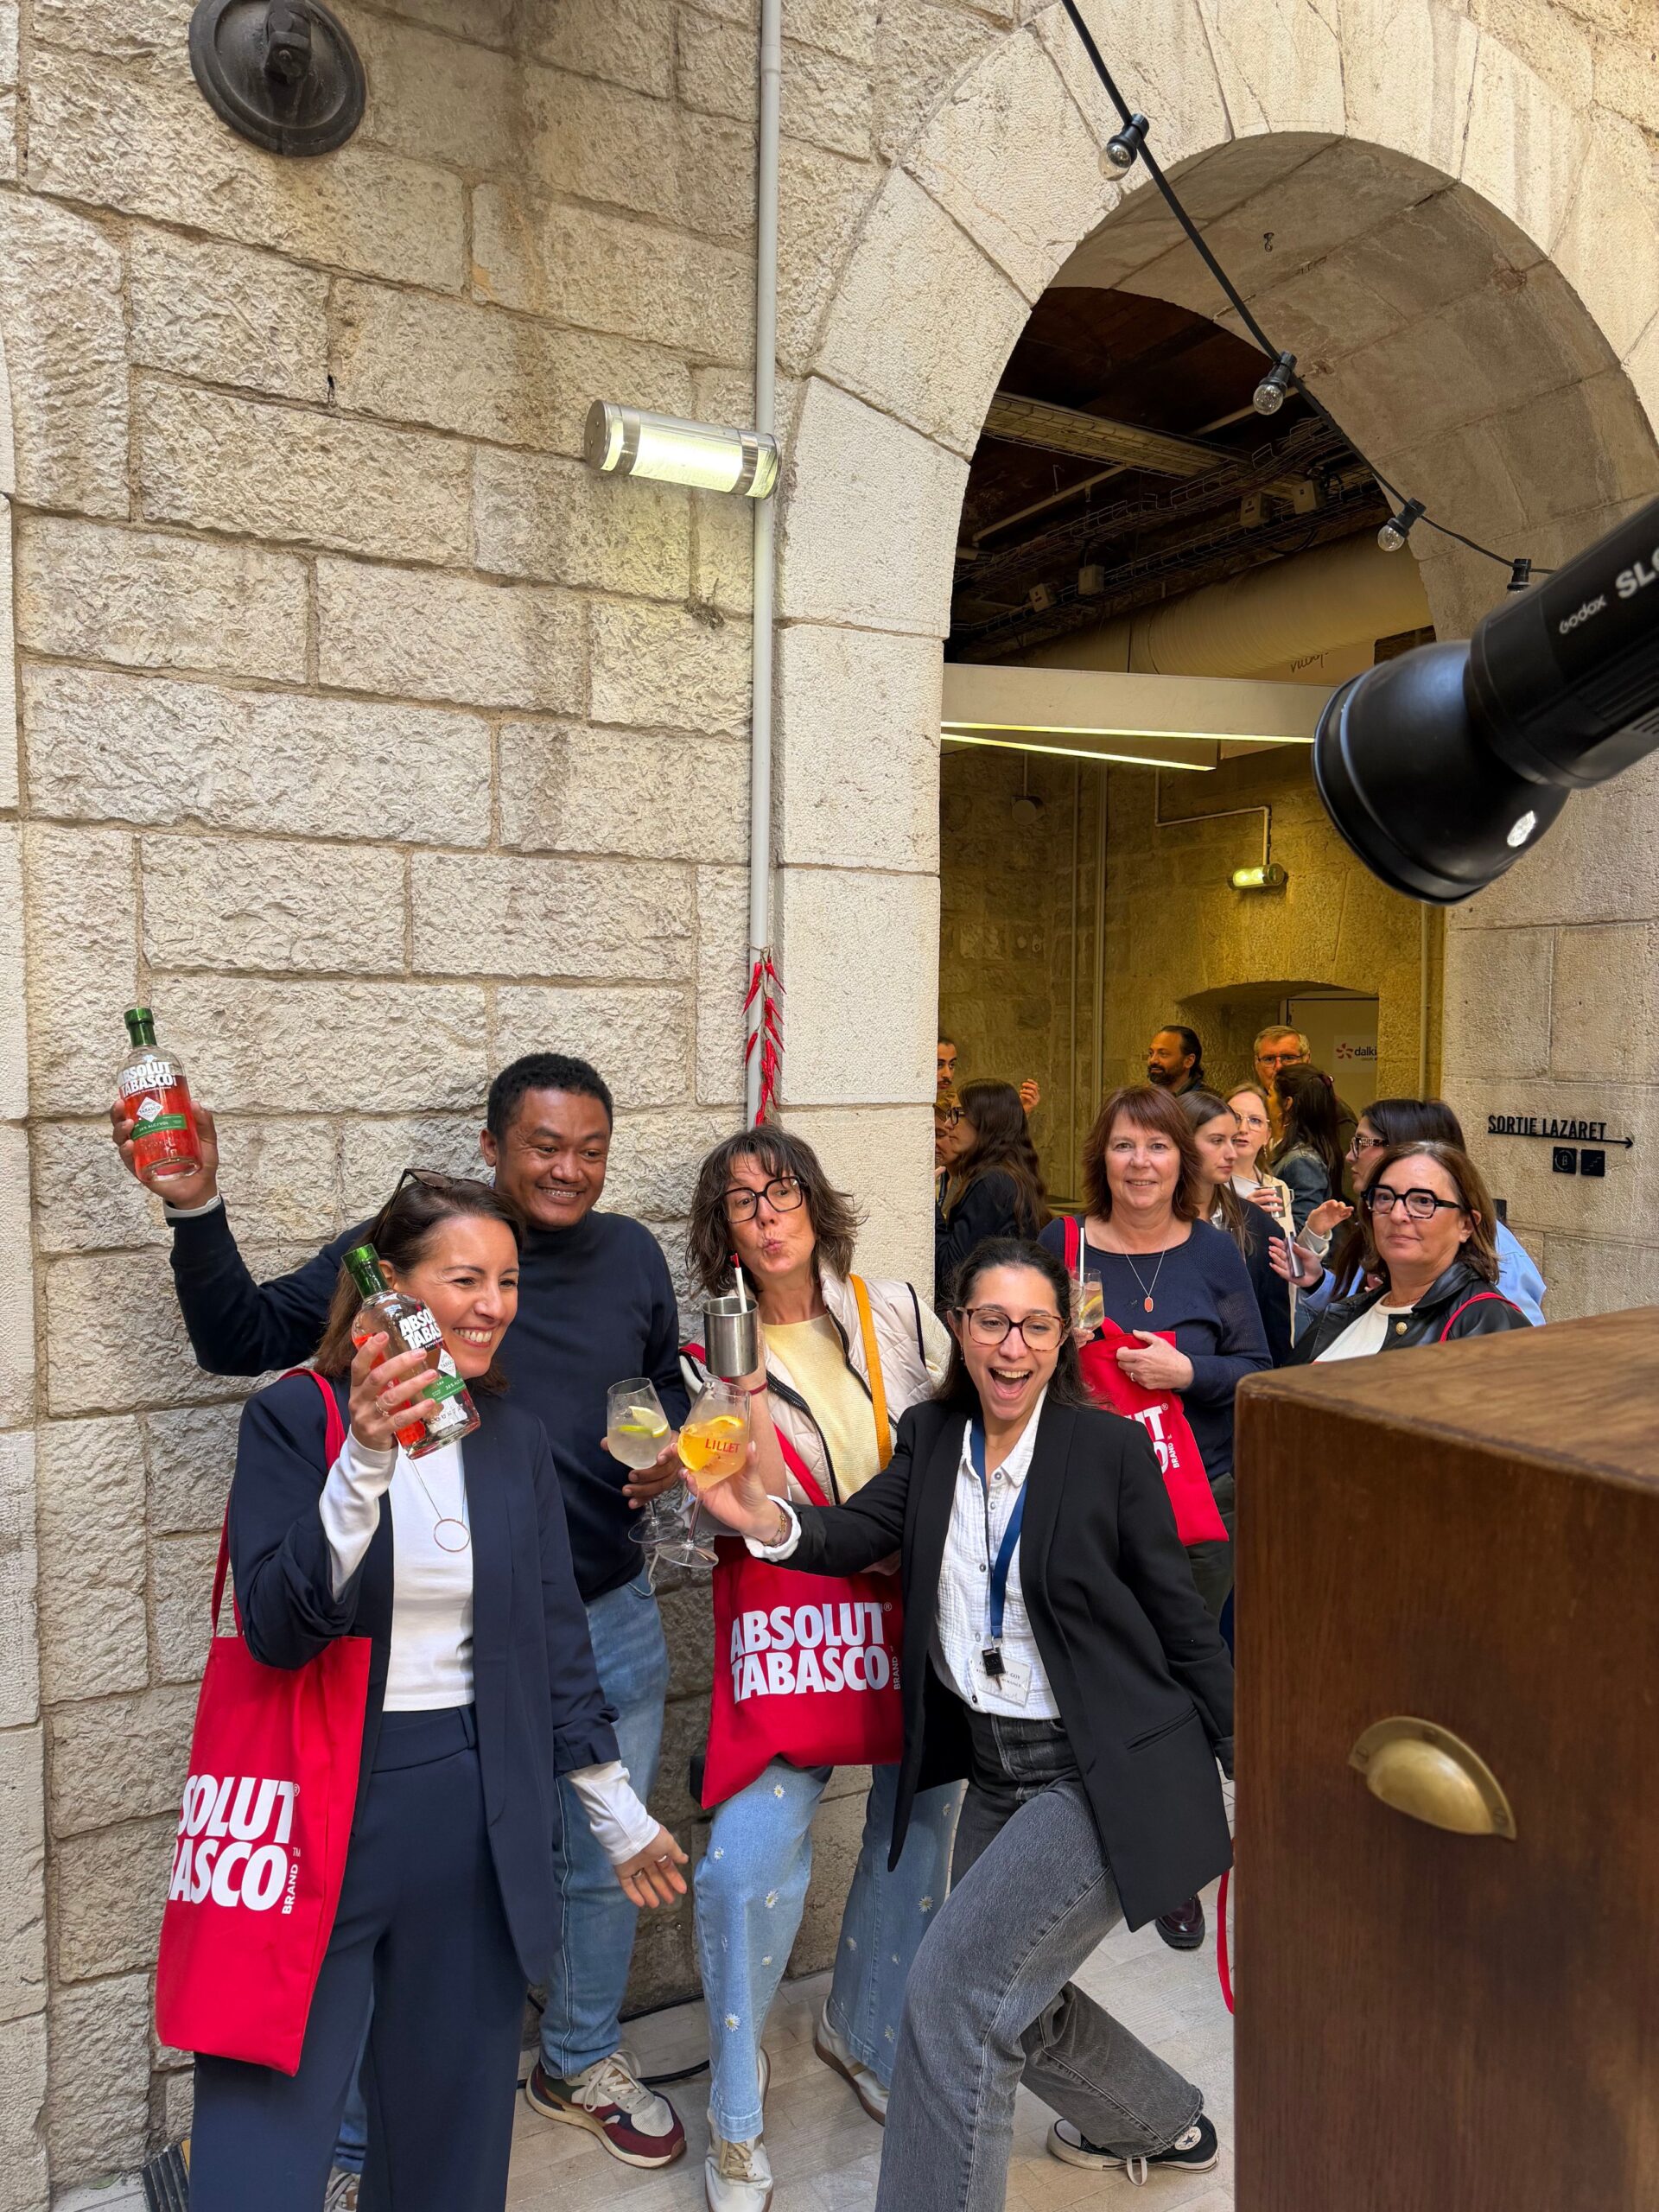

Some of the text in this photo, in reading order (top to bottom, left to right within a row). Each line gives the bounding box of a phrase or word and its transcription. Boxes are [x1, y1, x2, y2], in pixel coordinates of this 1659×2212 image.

[1354, 1046, 1377, 1056] dalki
[1488, 1115, 1607, 1140] SORTIE LAZARET
[398, 1308, 435, 1337] ABSO
[404, 1322, 442, 1351] TABAS
[705, 1438, 741, 1452] LILLET
[1167, 1442, 1180, 1469] BRAND
[730, 1602, 884, 1664] ABSOLUT
[731, 1645, 890, 1705] TABASCO
[892, 1656, 901, 1690] BRAND
[177, 1774, 294, 1844] SOLUT
[168, 1839, 288, 1911] ASCO
[282, 1864, 299, 1915] BRAND
